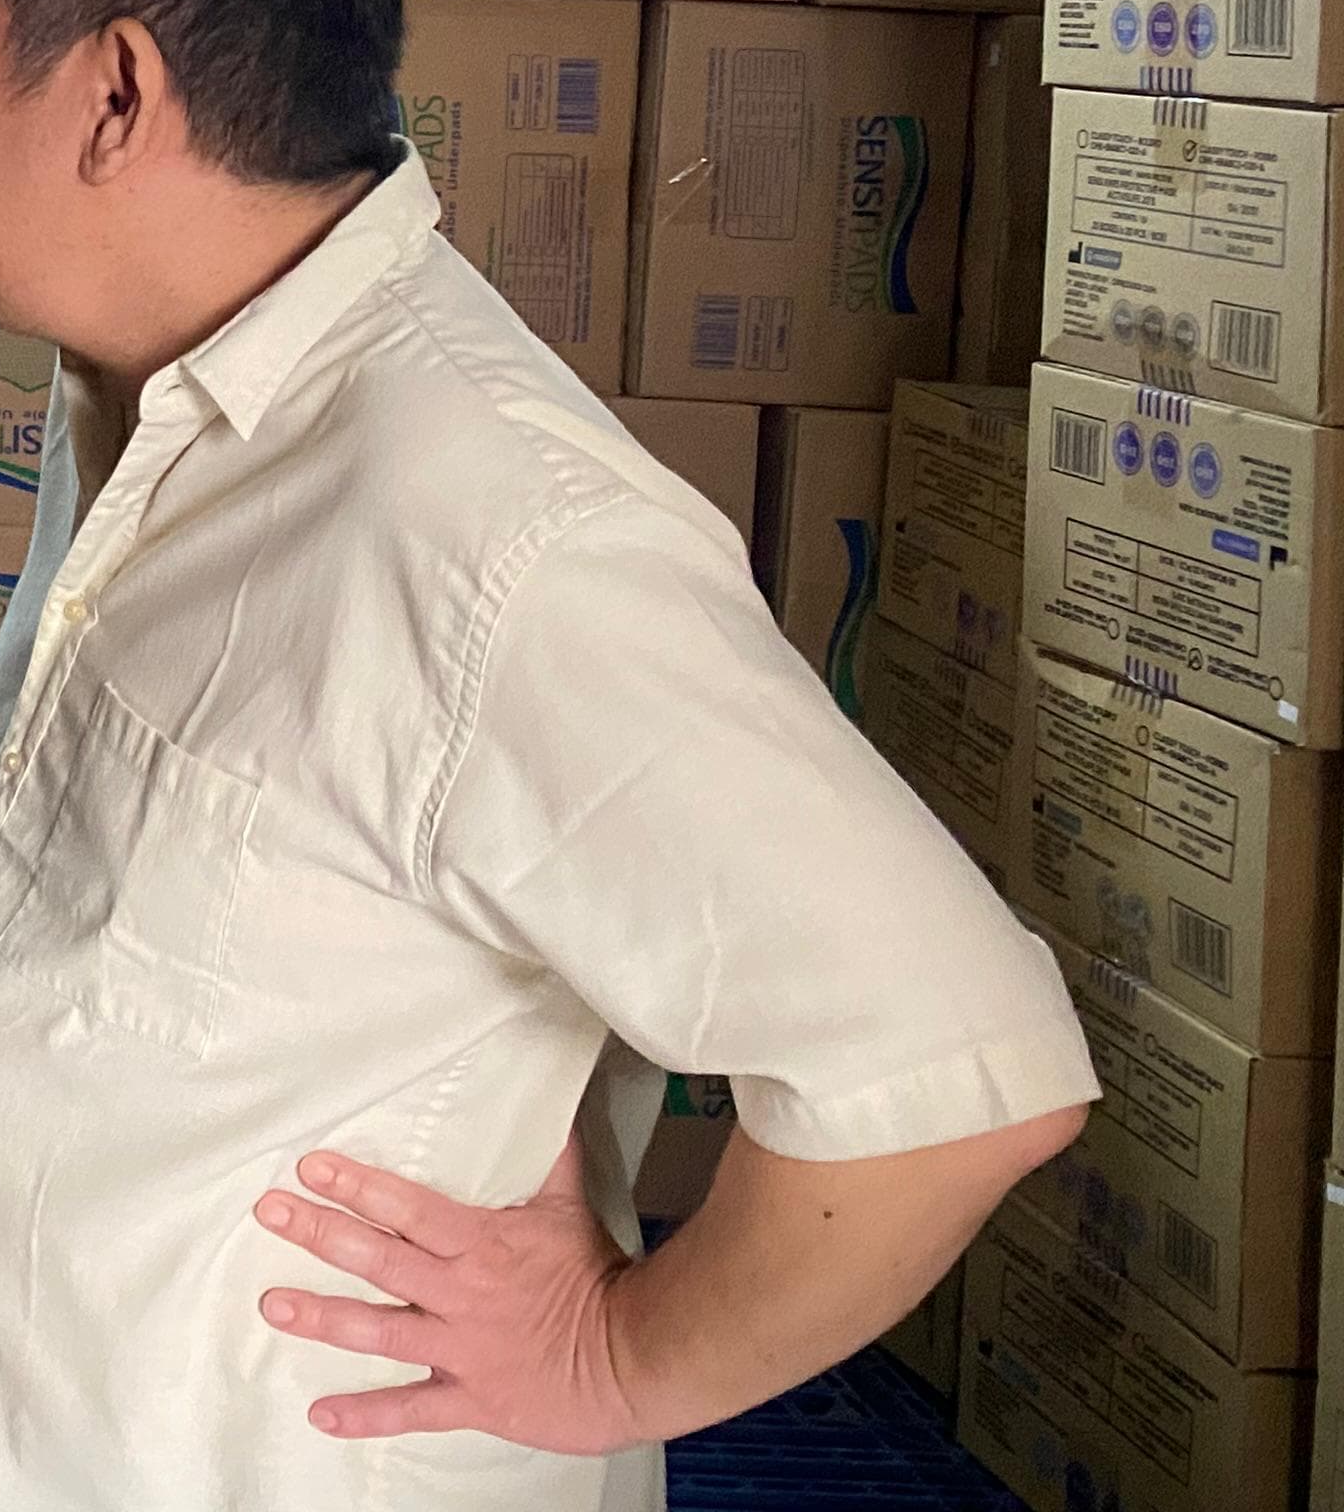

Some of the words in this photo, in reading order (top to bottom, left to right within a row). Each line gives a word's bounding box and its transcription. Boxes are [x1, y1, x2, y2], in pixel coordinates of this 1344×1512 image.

[446, 101, 462, 190] Underpads
[852, 115, 889, 217] SENSI
[846, 222, 879, 314] PADS
